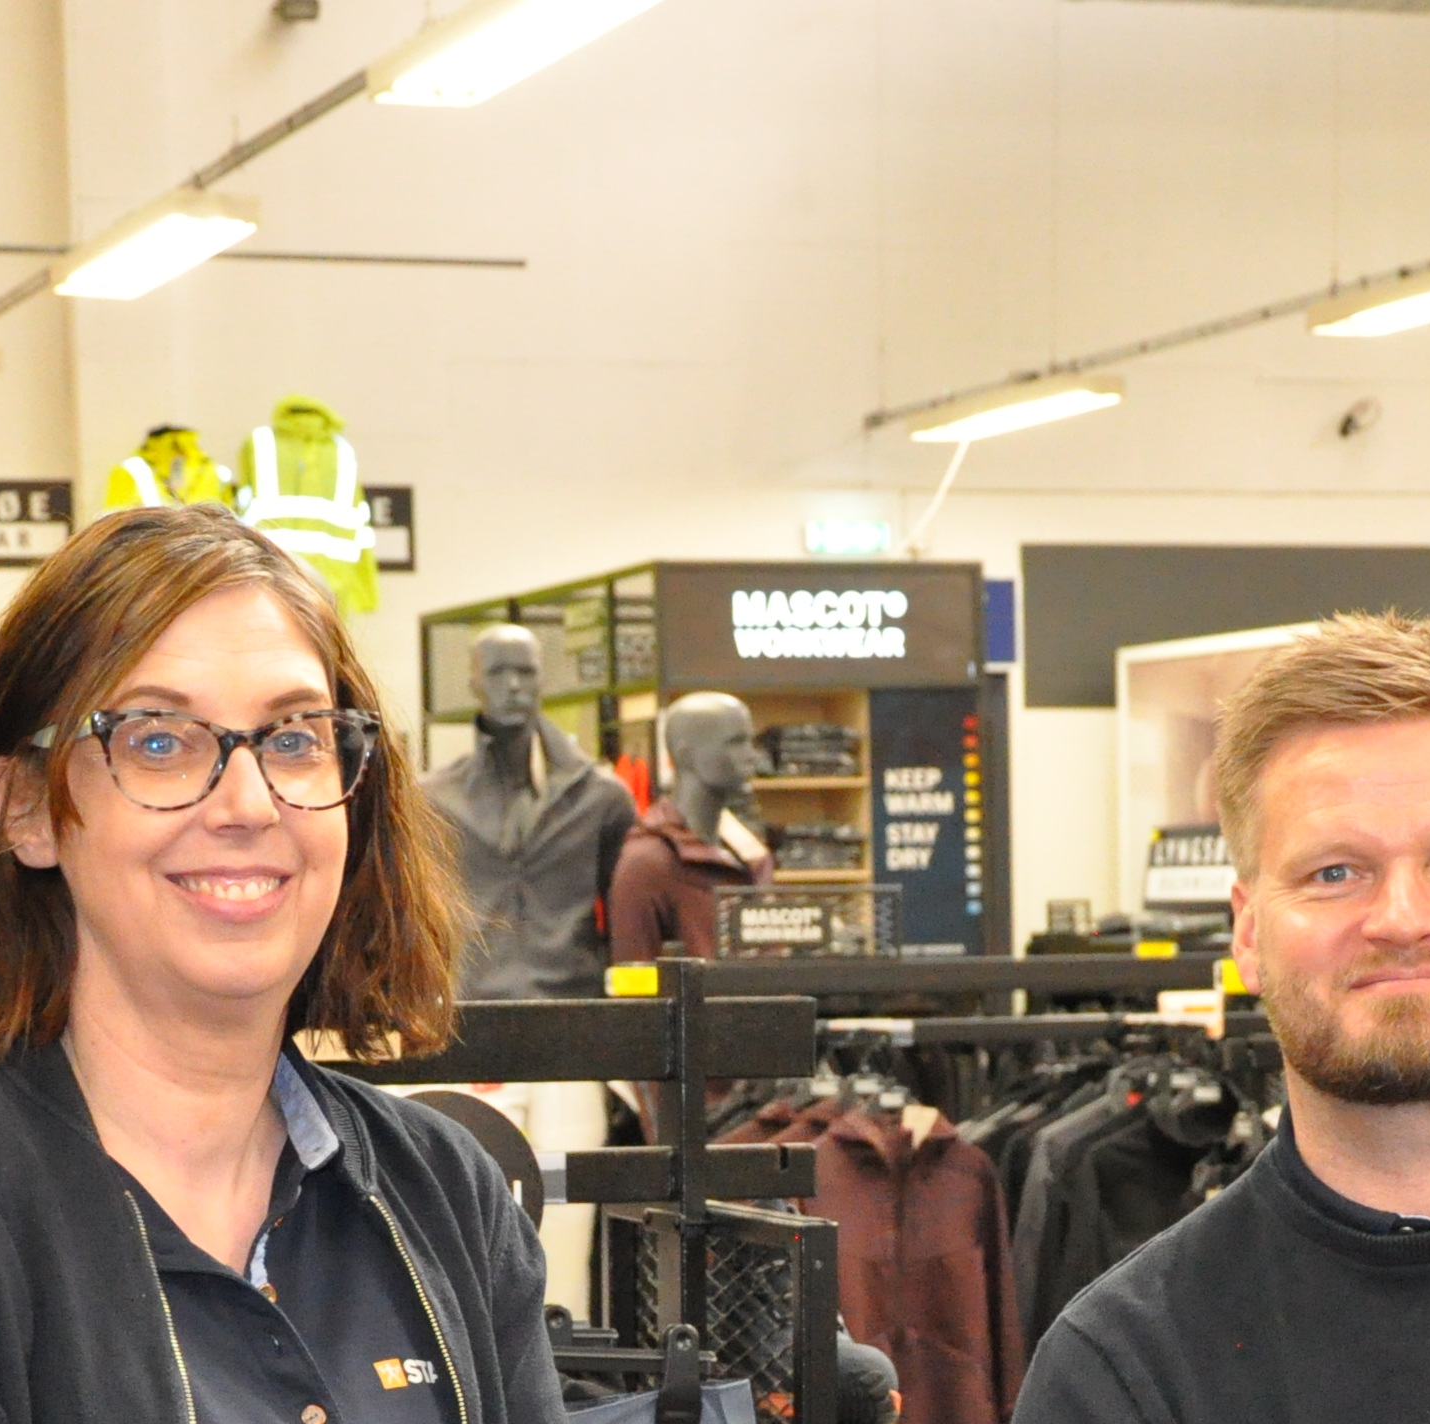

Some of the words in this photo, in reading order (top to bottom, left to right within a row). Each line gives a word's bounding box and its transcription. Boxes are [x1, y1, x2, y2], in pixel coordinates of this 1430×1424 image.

[883, 767, 942, 791] KEEP
[883, 791, 954, 816] WARM
[885, 822, 939, 847] STAY
[885, 846, 933, 871] DRY
